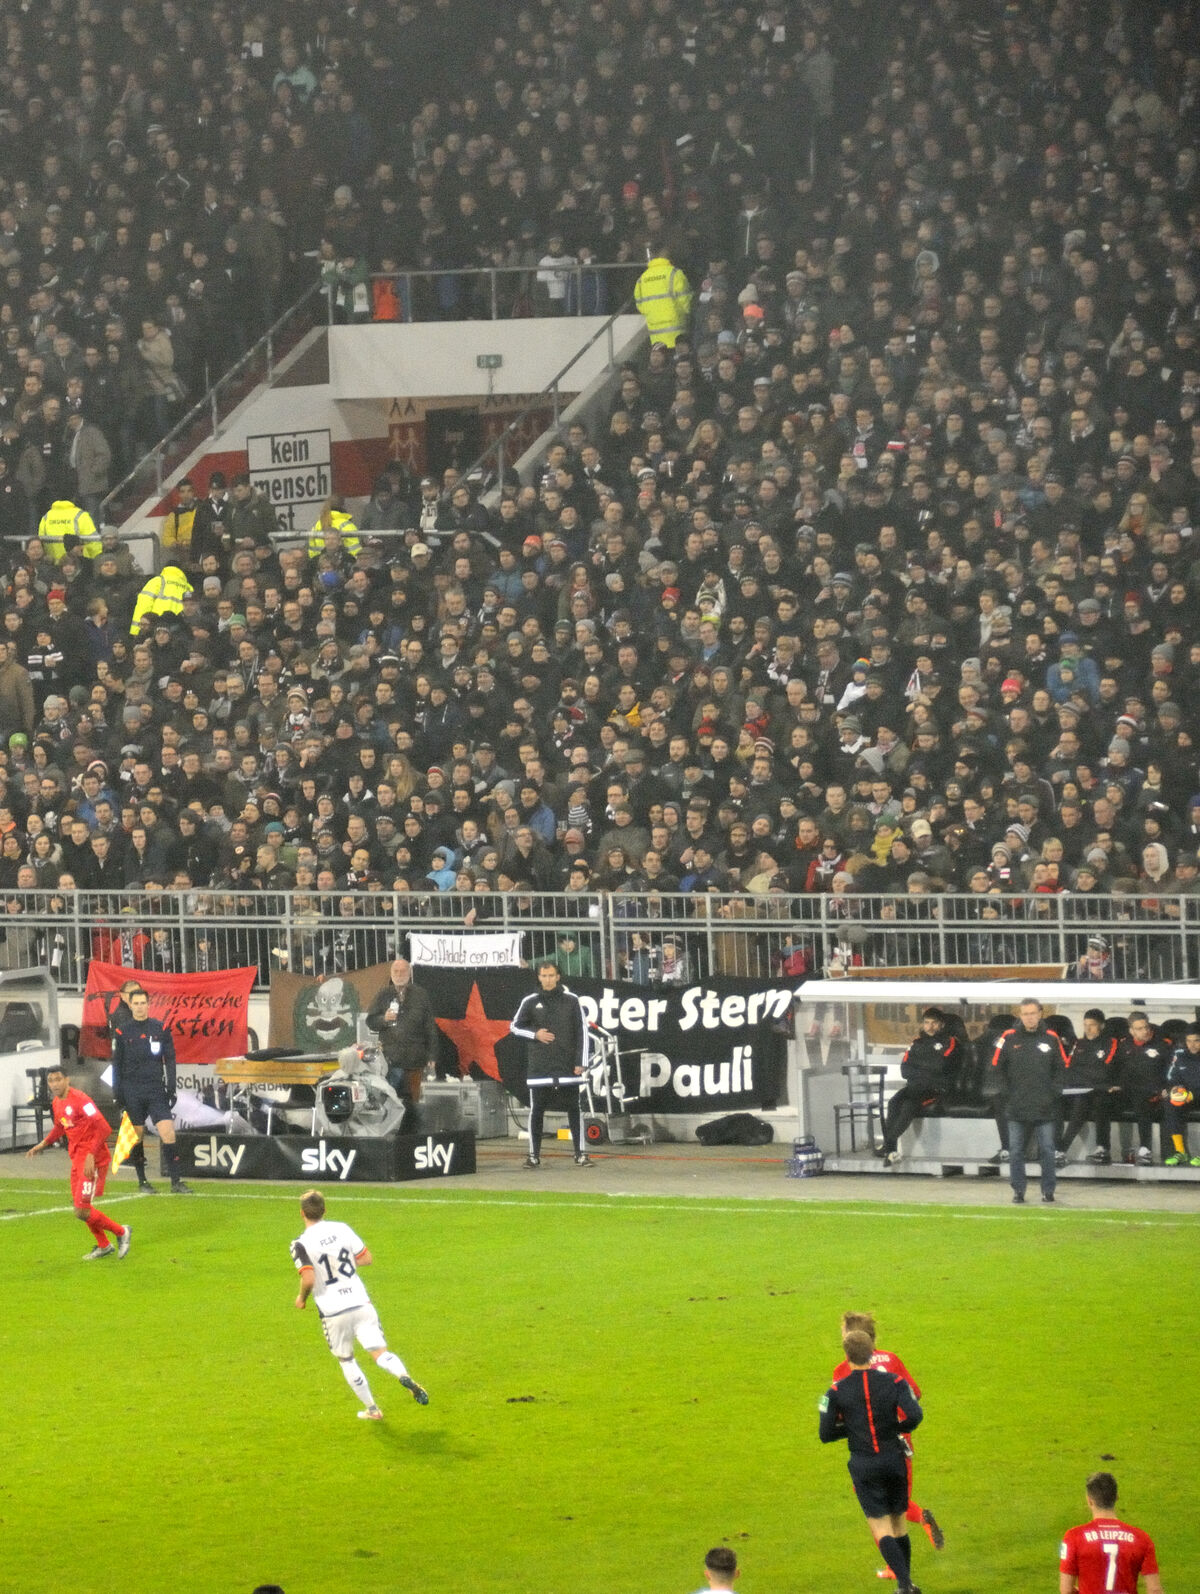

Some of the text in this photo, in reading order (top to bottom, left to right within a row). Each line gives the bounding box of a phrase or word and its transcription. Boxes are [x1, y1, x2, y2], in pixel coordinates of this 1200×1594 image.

[270, 434, 309, 464] kein
[254, 465, 328, 501] mensch
[469, 951, 488, 964] con
[492, 939, 516, 963] noi!
[579, 986, 792, 1032] oter Stern
[639, 1045, 753, 1098] Pauli
[194, 1136, 245, 1175] sky
[301, 1140, 356, 1180] sky
[414, 1136, 454, 1173] sky
[82, 1181, 93, 1195] 33
[318, 1247, 356, 1285] 18
[1084, 1531, 1135, 1543] RB LEIPZIG
[1103, 1543, 1119, 1591] 7
